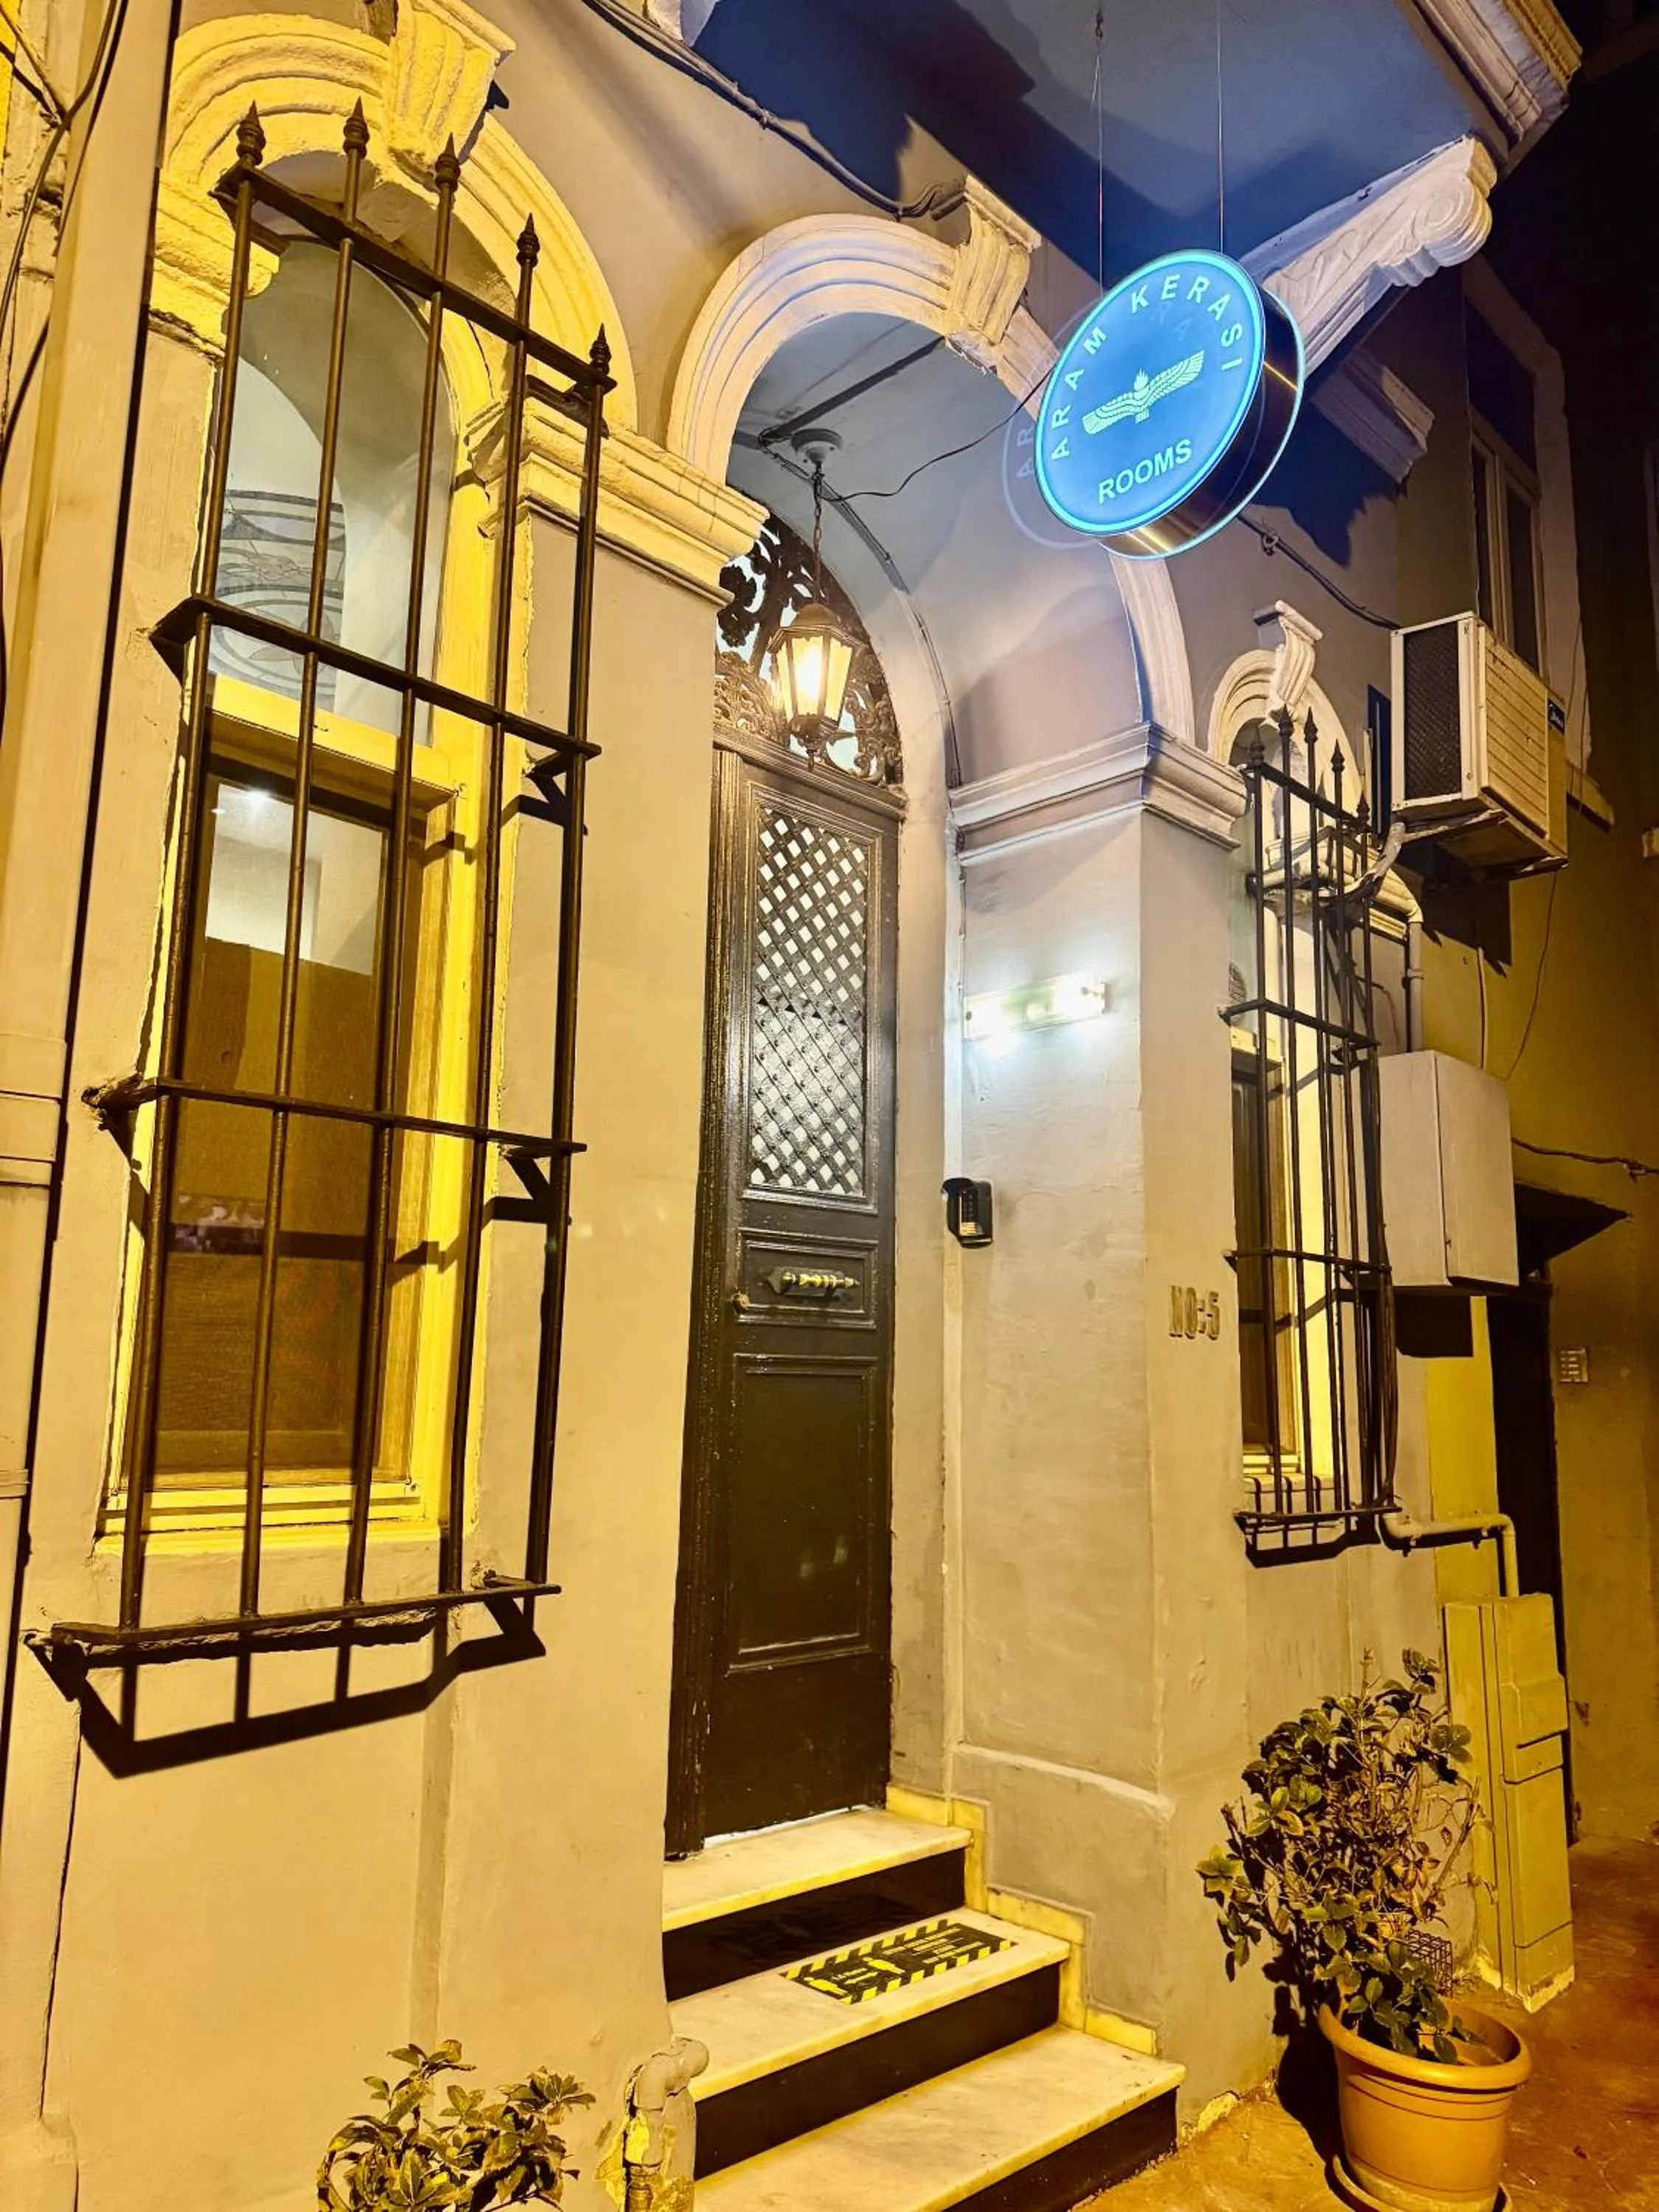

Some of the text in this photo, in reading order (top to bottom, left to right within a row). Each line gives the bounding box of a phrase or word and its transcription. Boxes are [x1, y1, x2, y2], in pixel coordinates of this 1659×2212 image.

[1051, 326, 1107, 461] ARAM
[1130, 274, 1243, 372] KERASI
[1097, 438, 1192, 505] ROOMS
